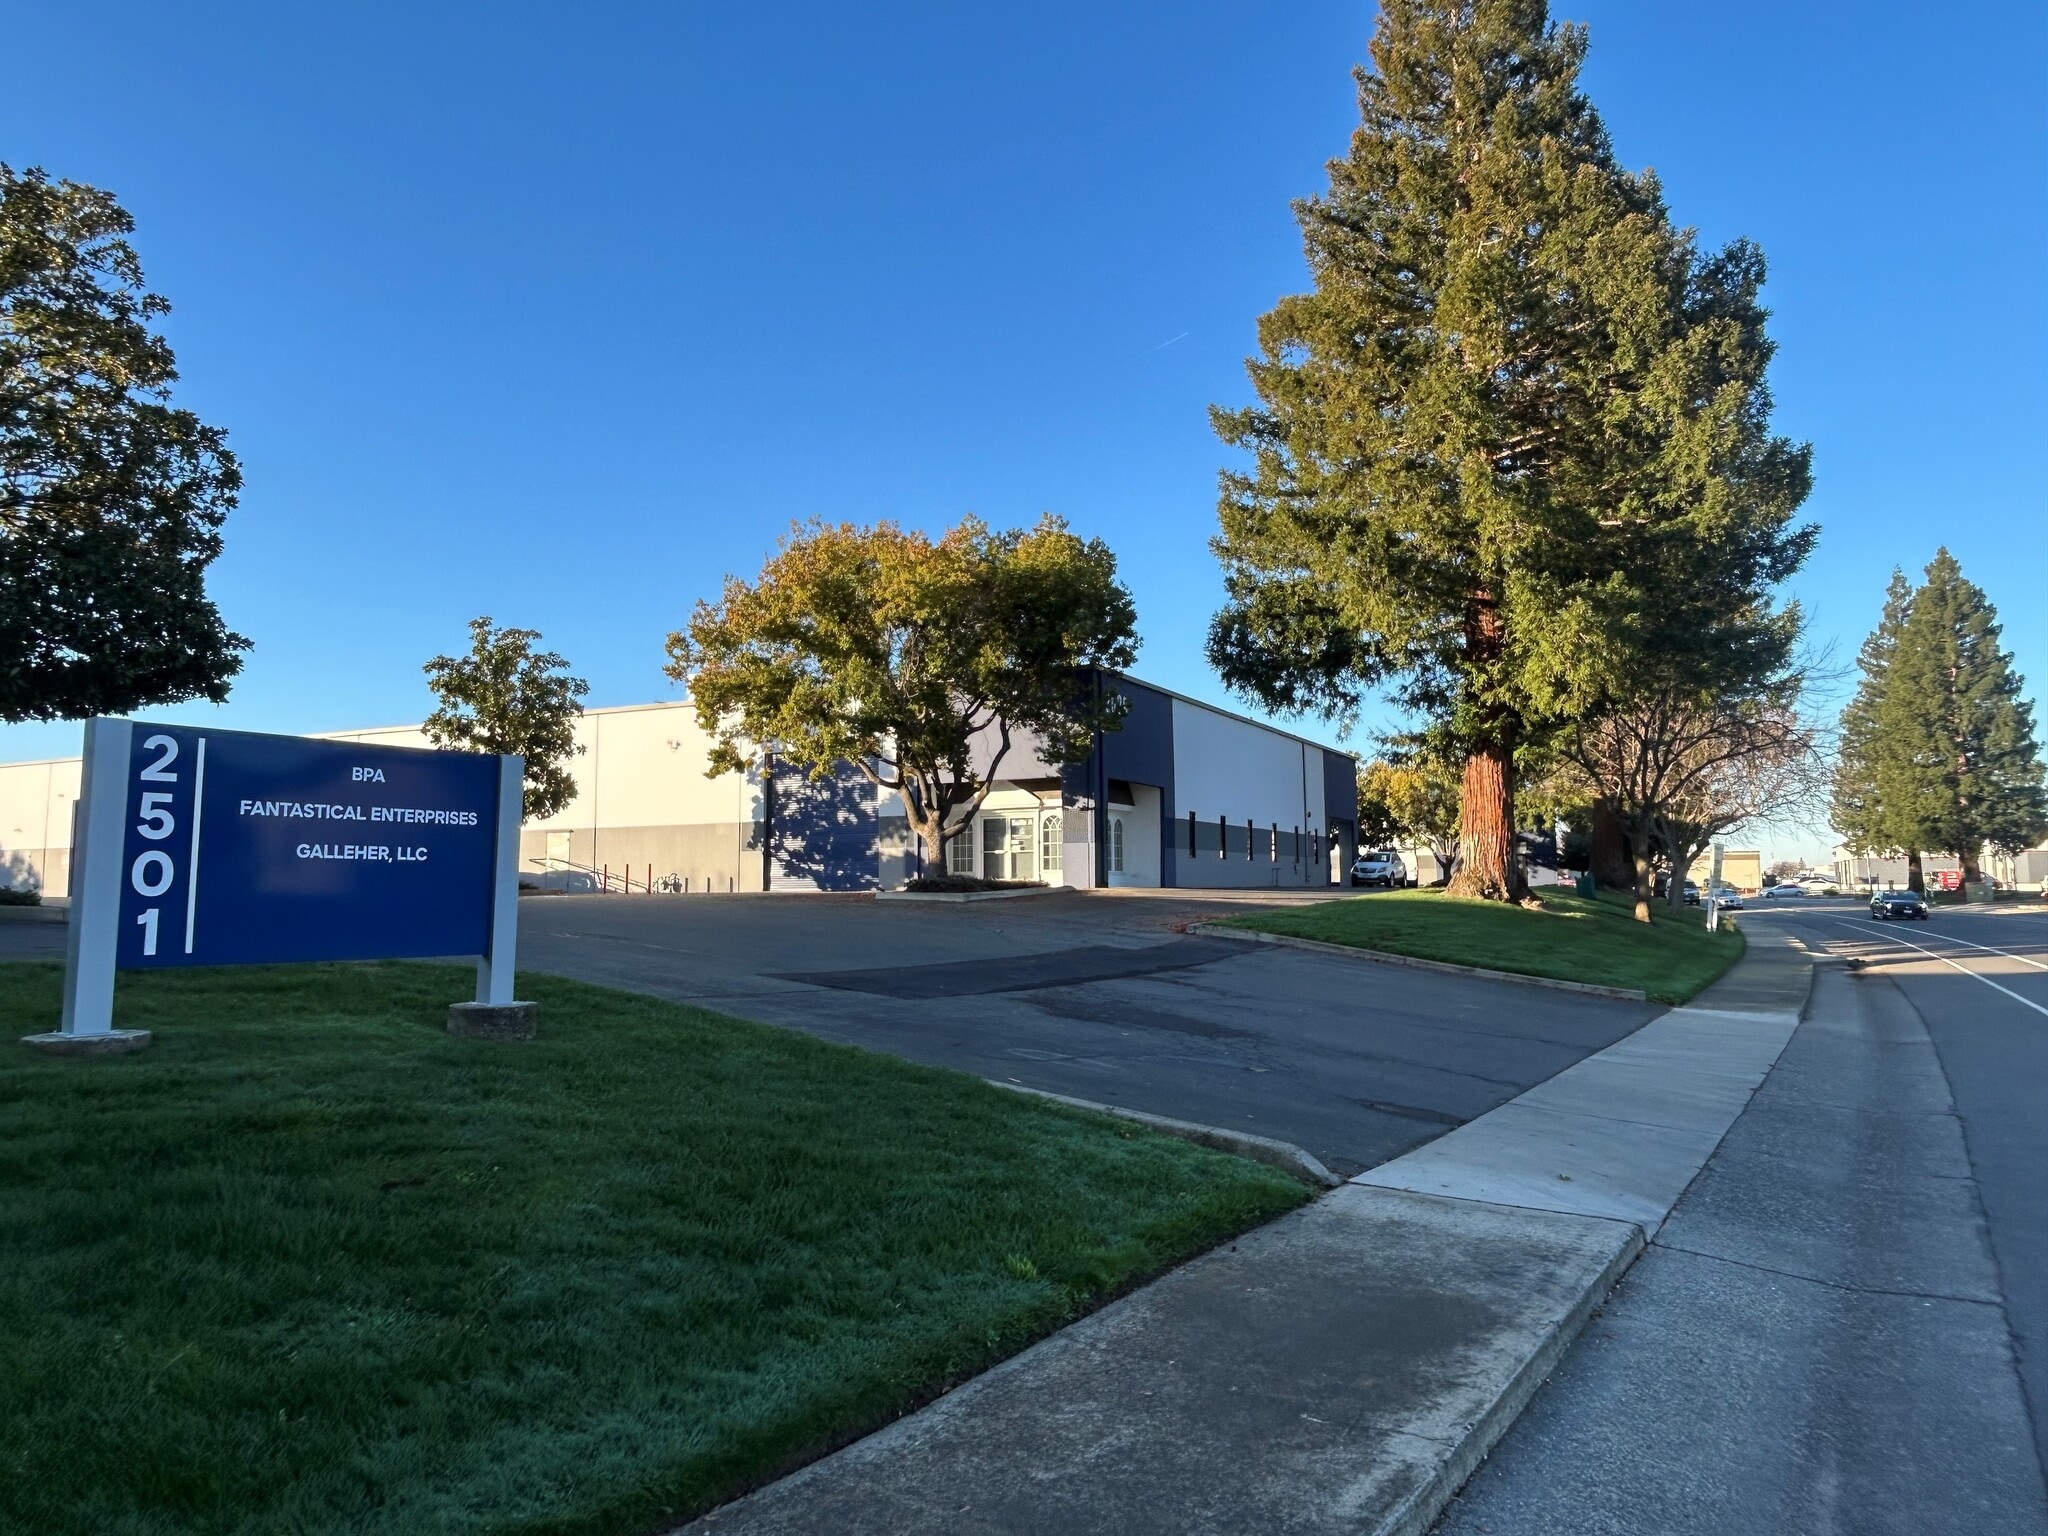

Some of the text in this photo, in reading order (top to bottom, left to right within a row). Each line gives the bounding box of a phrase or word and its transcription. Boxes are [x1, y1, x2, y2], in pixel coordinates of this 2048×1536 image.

[352, 767, 386, 783] BPA
[239, 800, 478, 826] FANTASTICAL ENTERPRISES
[131, 734, 179, 956] 2501
[296, 843, 428, 863] GALLEHER, LLC
